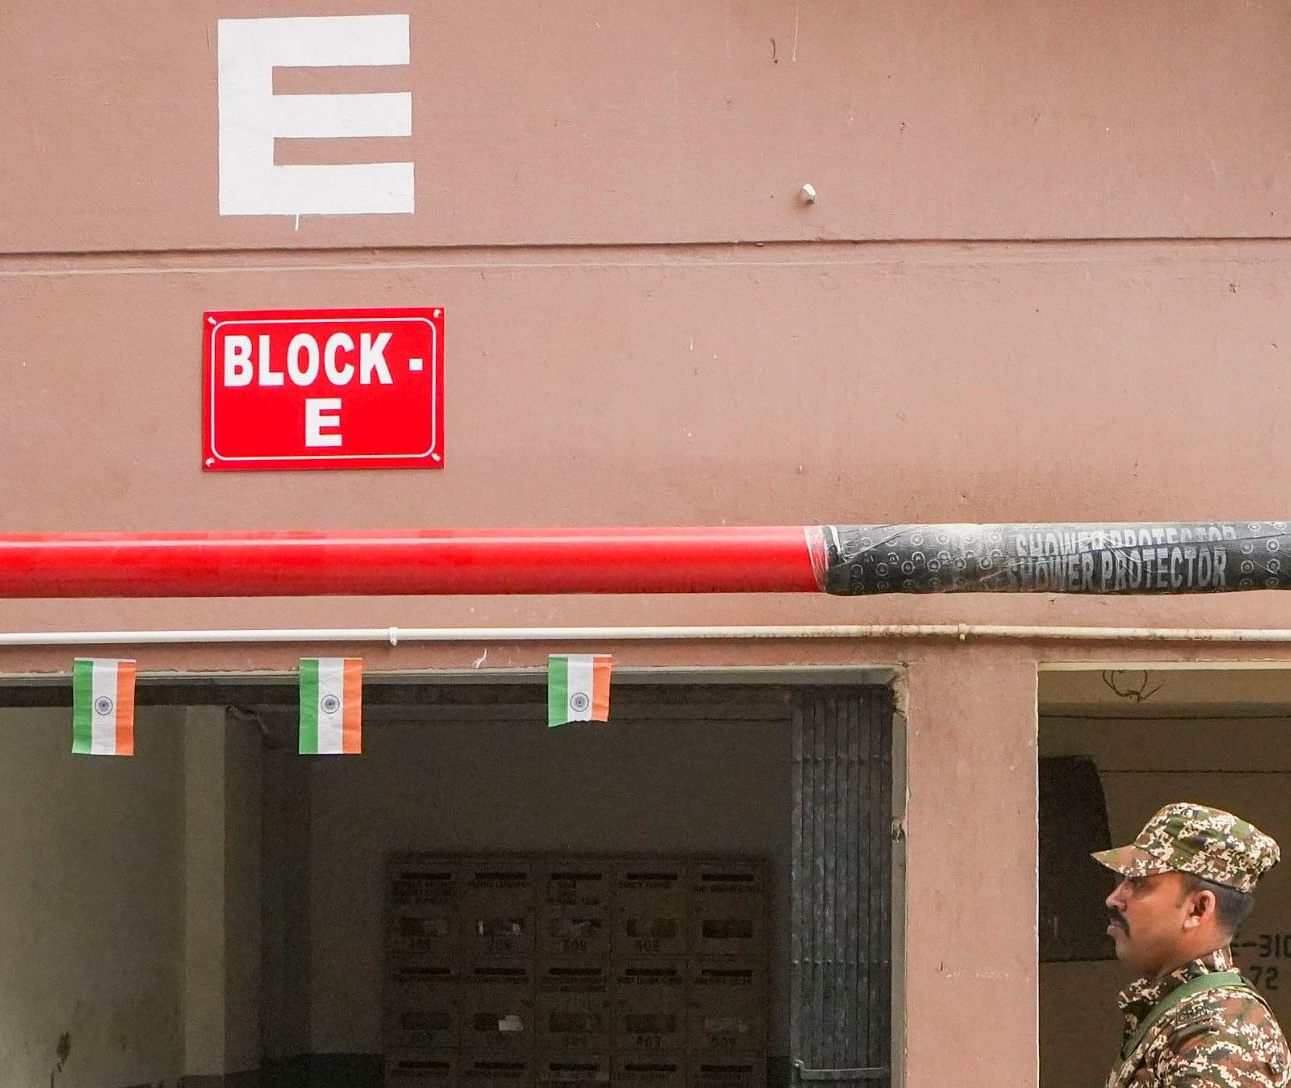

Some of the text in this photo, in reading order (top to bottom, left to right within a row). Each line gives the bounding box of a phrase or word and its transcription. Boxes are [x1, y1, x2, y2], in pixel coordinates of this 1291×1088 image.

[217, 14, 415, 216] E
[223, 332, 393, 388] BLOCK
[304, 397, 343, 448] E
[1007, 547, 1228, 591] SHOWER PROTECTOR
